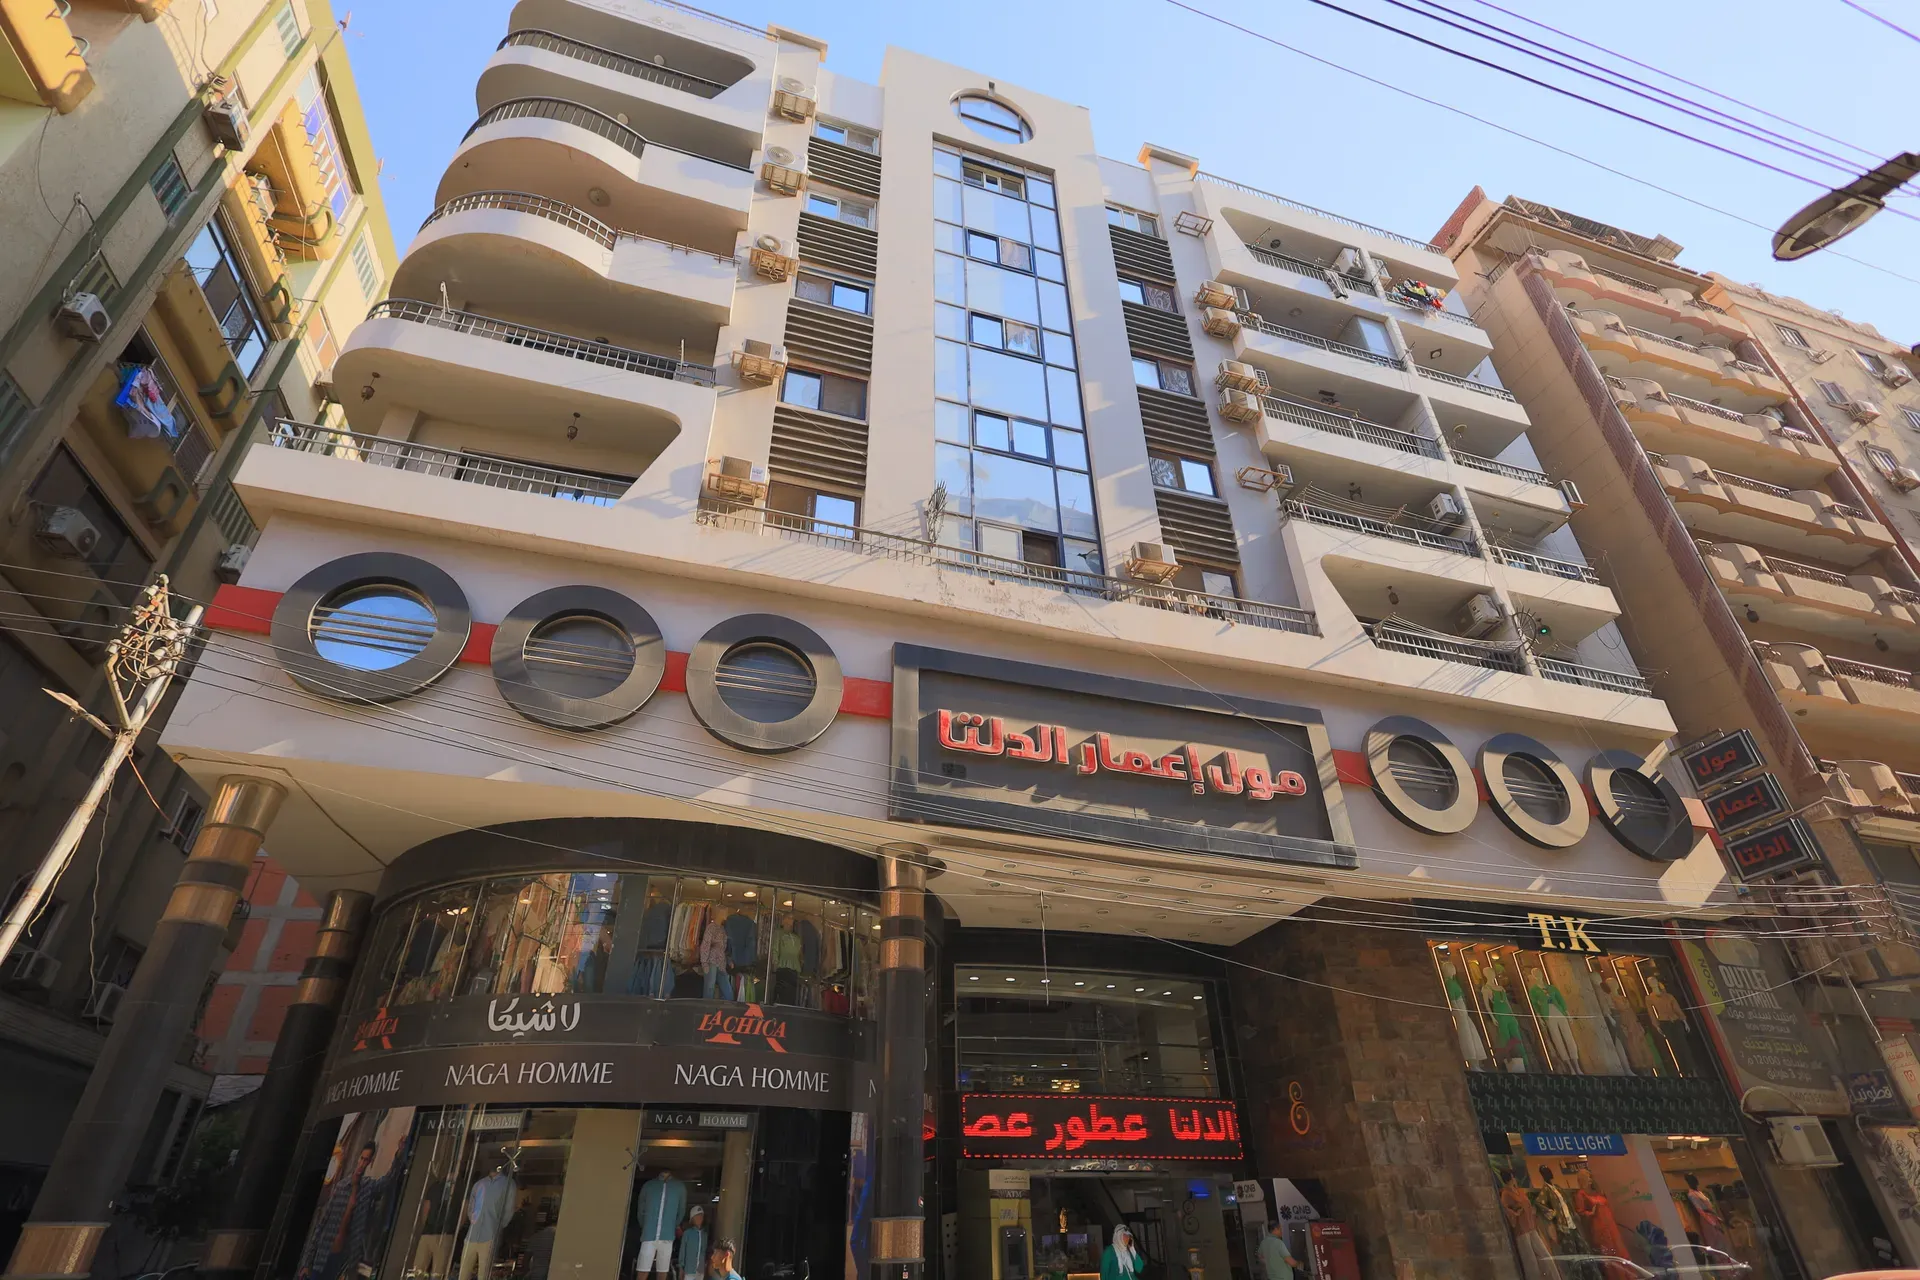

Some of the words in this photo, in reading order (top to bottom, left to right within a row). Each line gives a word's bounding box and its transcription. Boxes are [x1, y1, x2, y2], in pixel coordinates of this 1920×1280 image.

[937, 708, 1070, 765] الدلتا
[1077, 731, 1205, 795] إعمار
[1206, 750, 1307, 800] مول
[1696, 749, 1738, 777] مول
[1715, 785, 1769, 823] إعمار
[1735, 834, 1792, 867] الدلتا
[1527, 912, 1602, 953] T.K
[1718, 964, 1768, 990] OUTLET
[487, 997, 581, 1038] لاشيكا
[443, 1063, 509, 1087] NAGA
[517, 1062, 615, 1085] HOMME
[1754, 1054, 1781, 1066] 12000
[347, 1069, 404, 1098] HOMME
[673, 1063, 744, 1088] NAGA
[750, 1067, 831, 1093] HOMME
[427, 1116, 465, 1130] NAGA
[655, 1113, 693, 1126] NAGA
[703, 1115, 745, 1126] HOMME
[1045, 1103, 1149, 1151] عطور
[1168, 1108, 1236, 1141] الدلتا
[1537, 1136, 1572, 1151] BLUE
[1577, 1135, 1613, 1151] LIGHT
[1005, 1190, 1022, 1198] ATM
[1243, 1183, 1256, 1193] QNB
[1292, 1205, 1312, 1215] QNB
